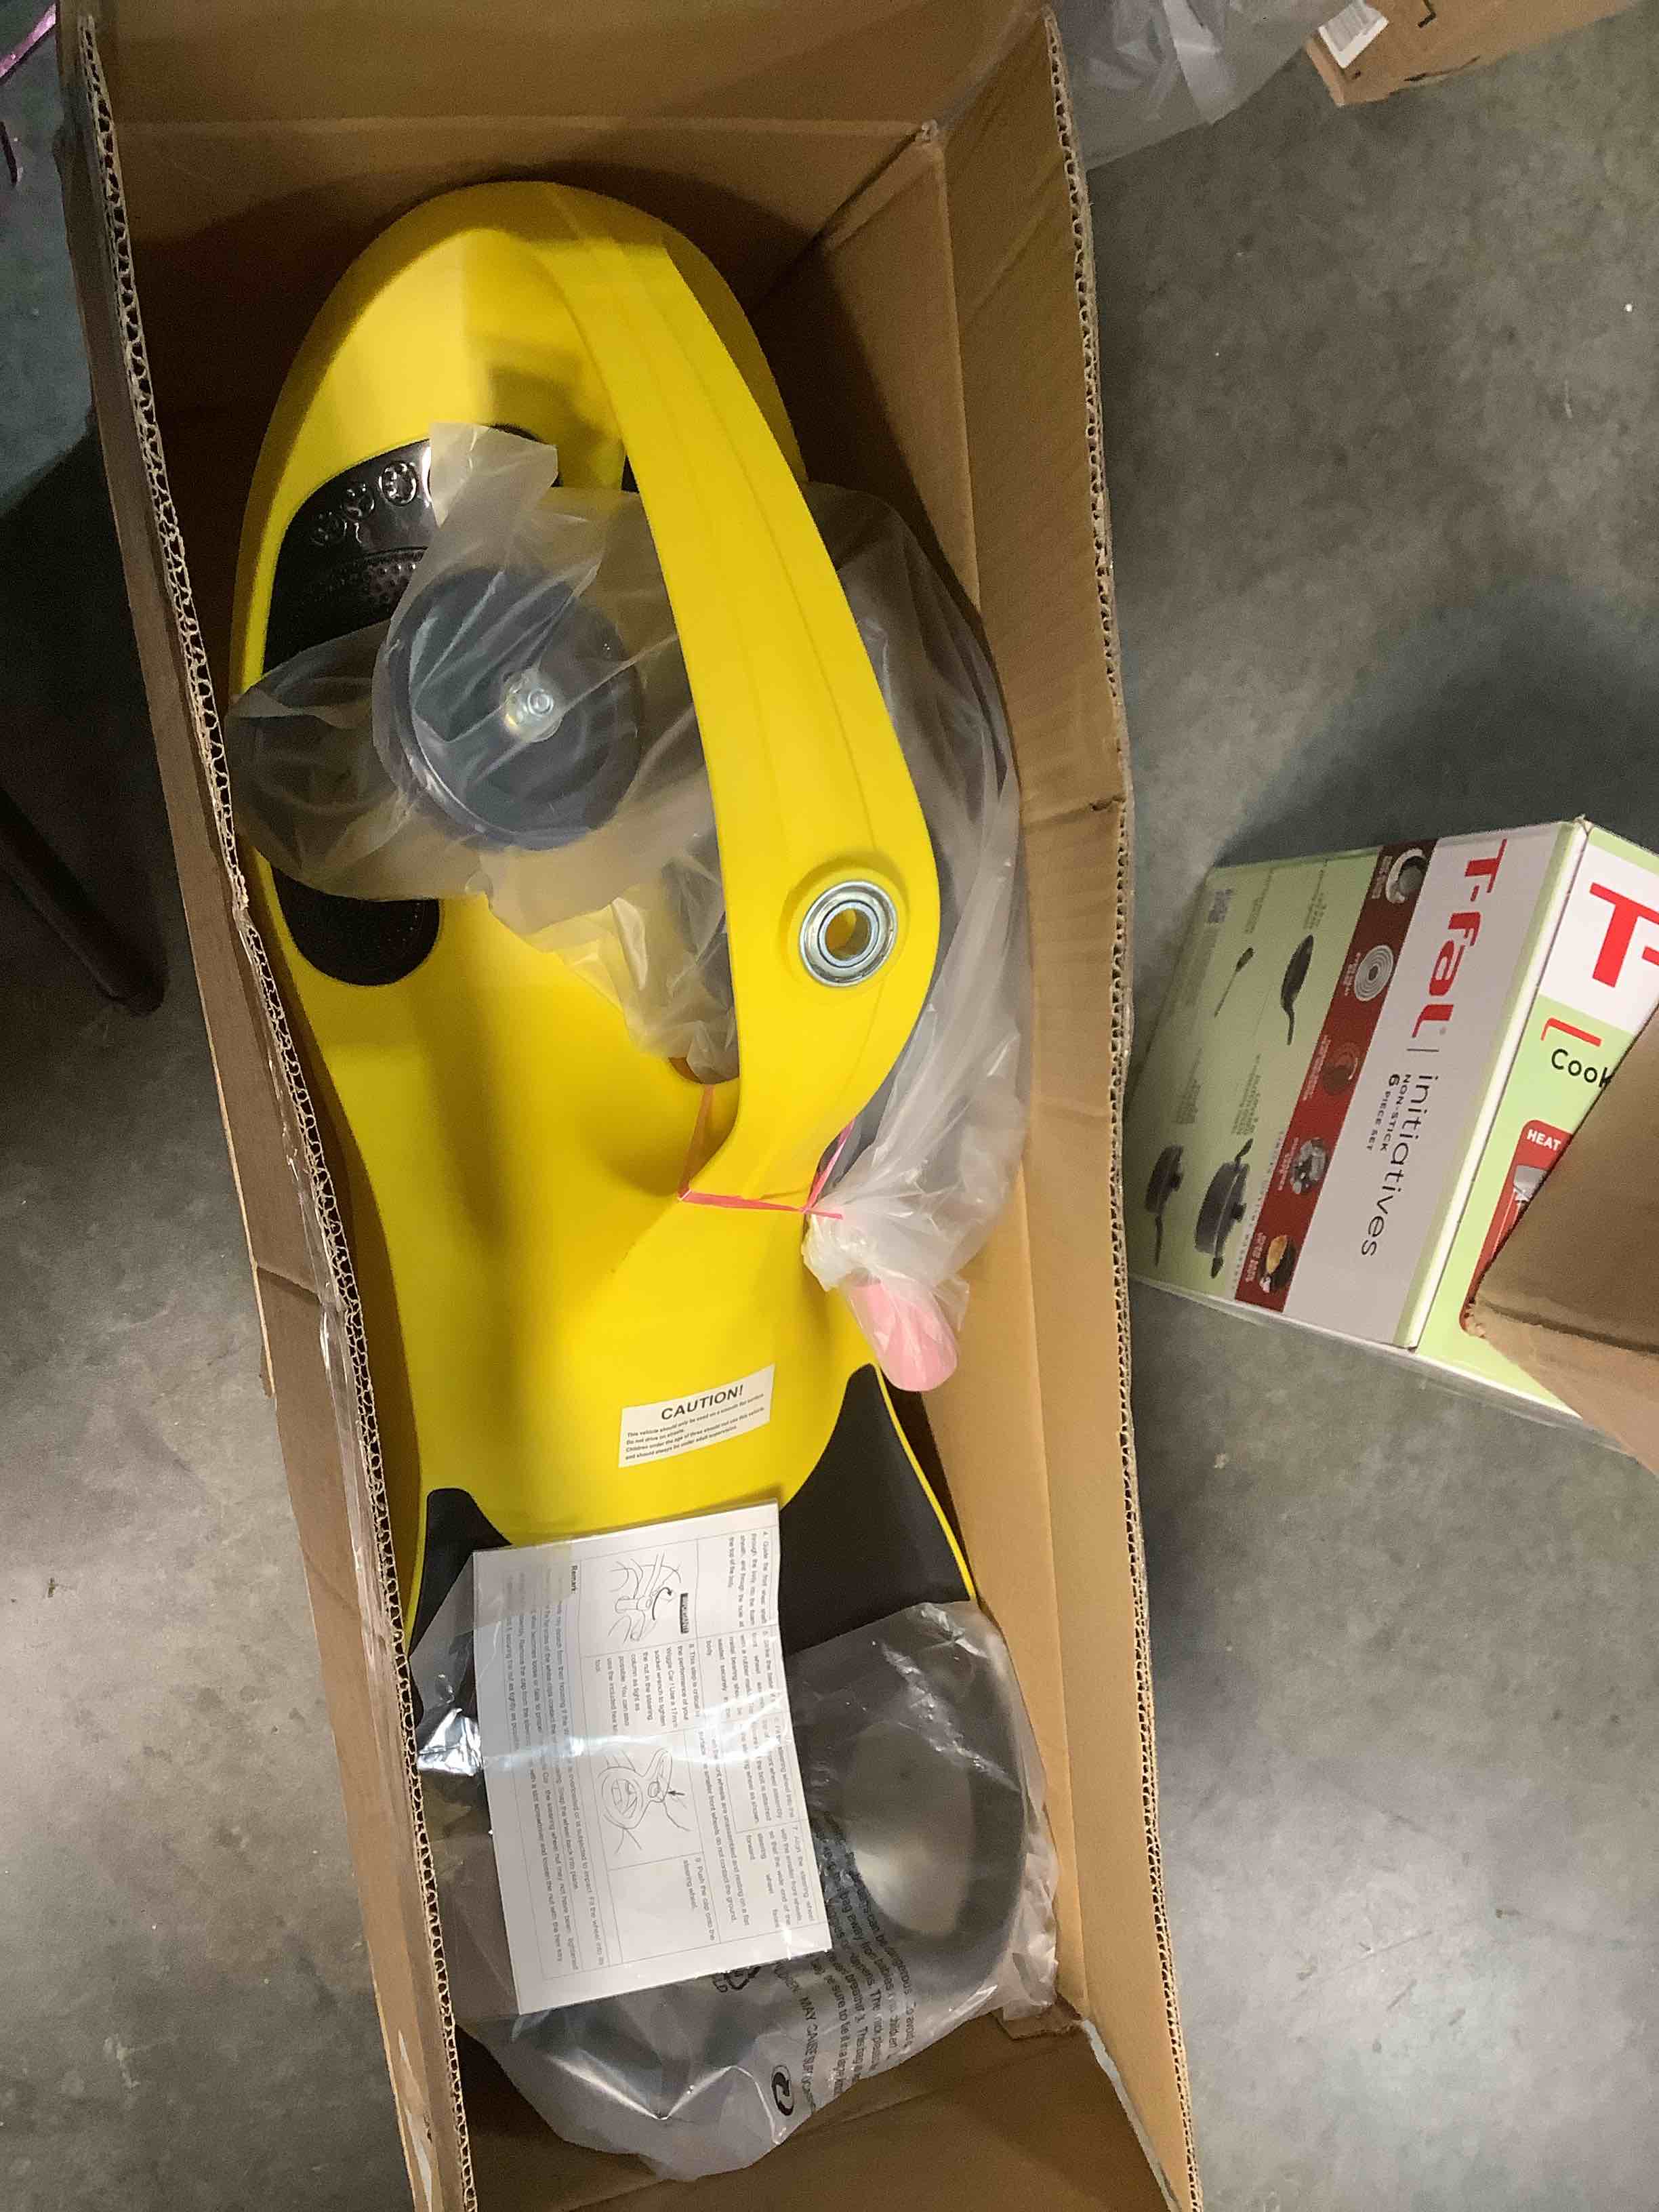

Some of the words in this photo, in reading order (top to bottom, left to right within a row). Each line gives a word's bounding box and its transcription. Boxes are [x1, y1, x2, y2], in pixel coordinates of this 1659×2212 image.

[1410, 838, 1509, 1040] T-fal
[1387, 1073, 1401, 1087] 6
[1372, 1090, 1391, 1126] PIECE
[1378, 1073, 1412, 1151] NON-STICK
[1364, 1128, 1378, 1151] SET
[1527, 1128, 1561, 1151] HEAT
[1359, 1073, 1439, 1258] initiatives
[661, 1384, 743, 1420] CAUTION!
[570, 1564, 578, 1595] Remark:
[697, 1865, 705, 1884] Push
[798, 1996, 817, 2021] MAY
